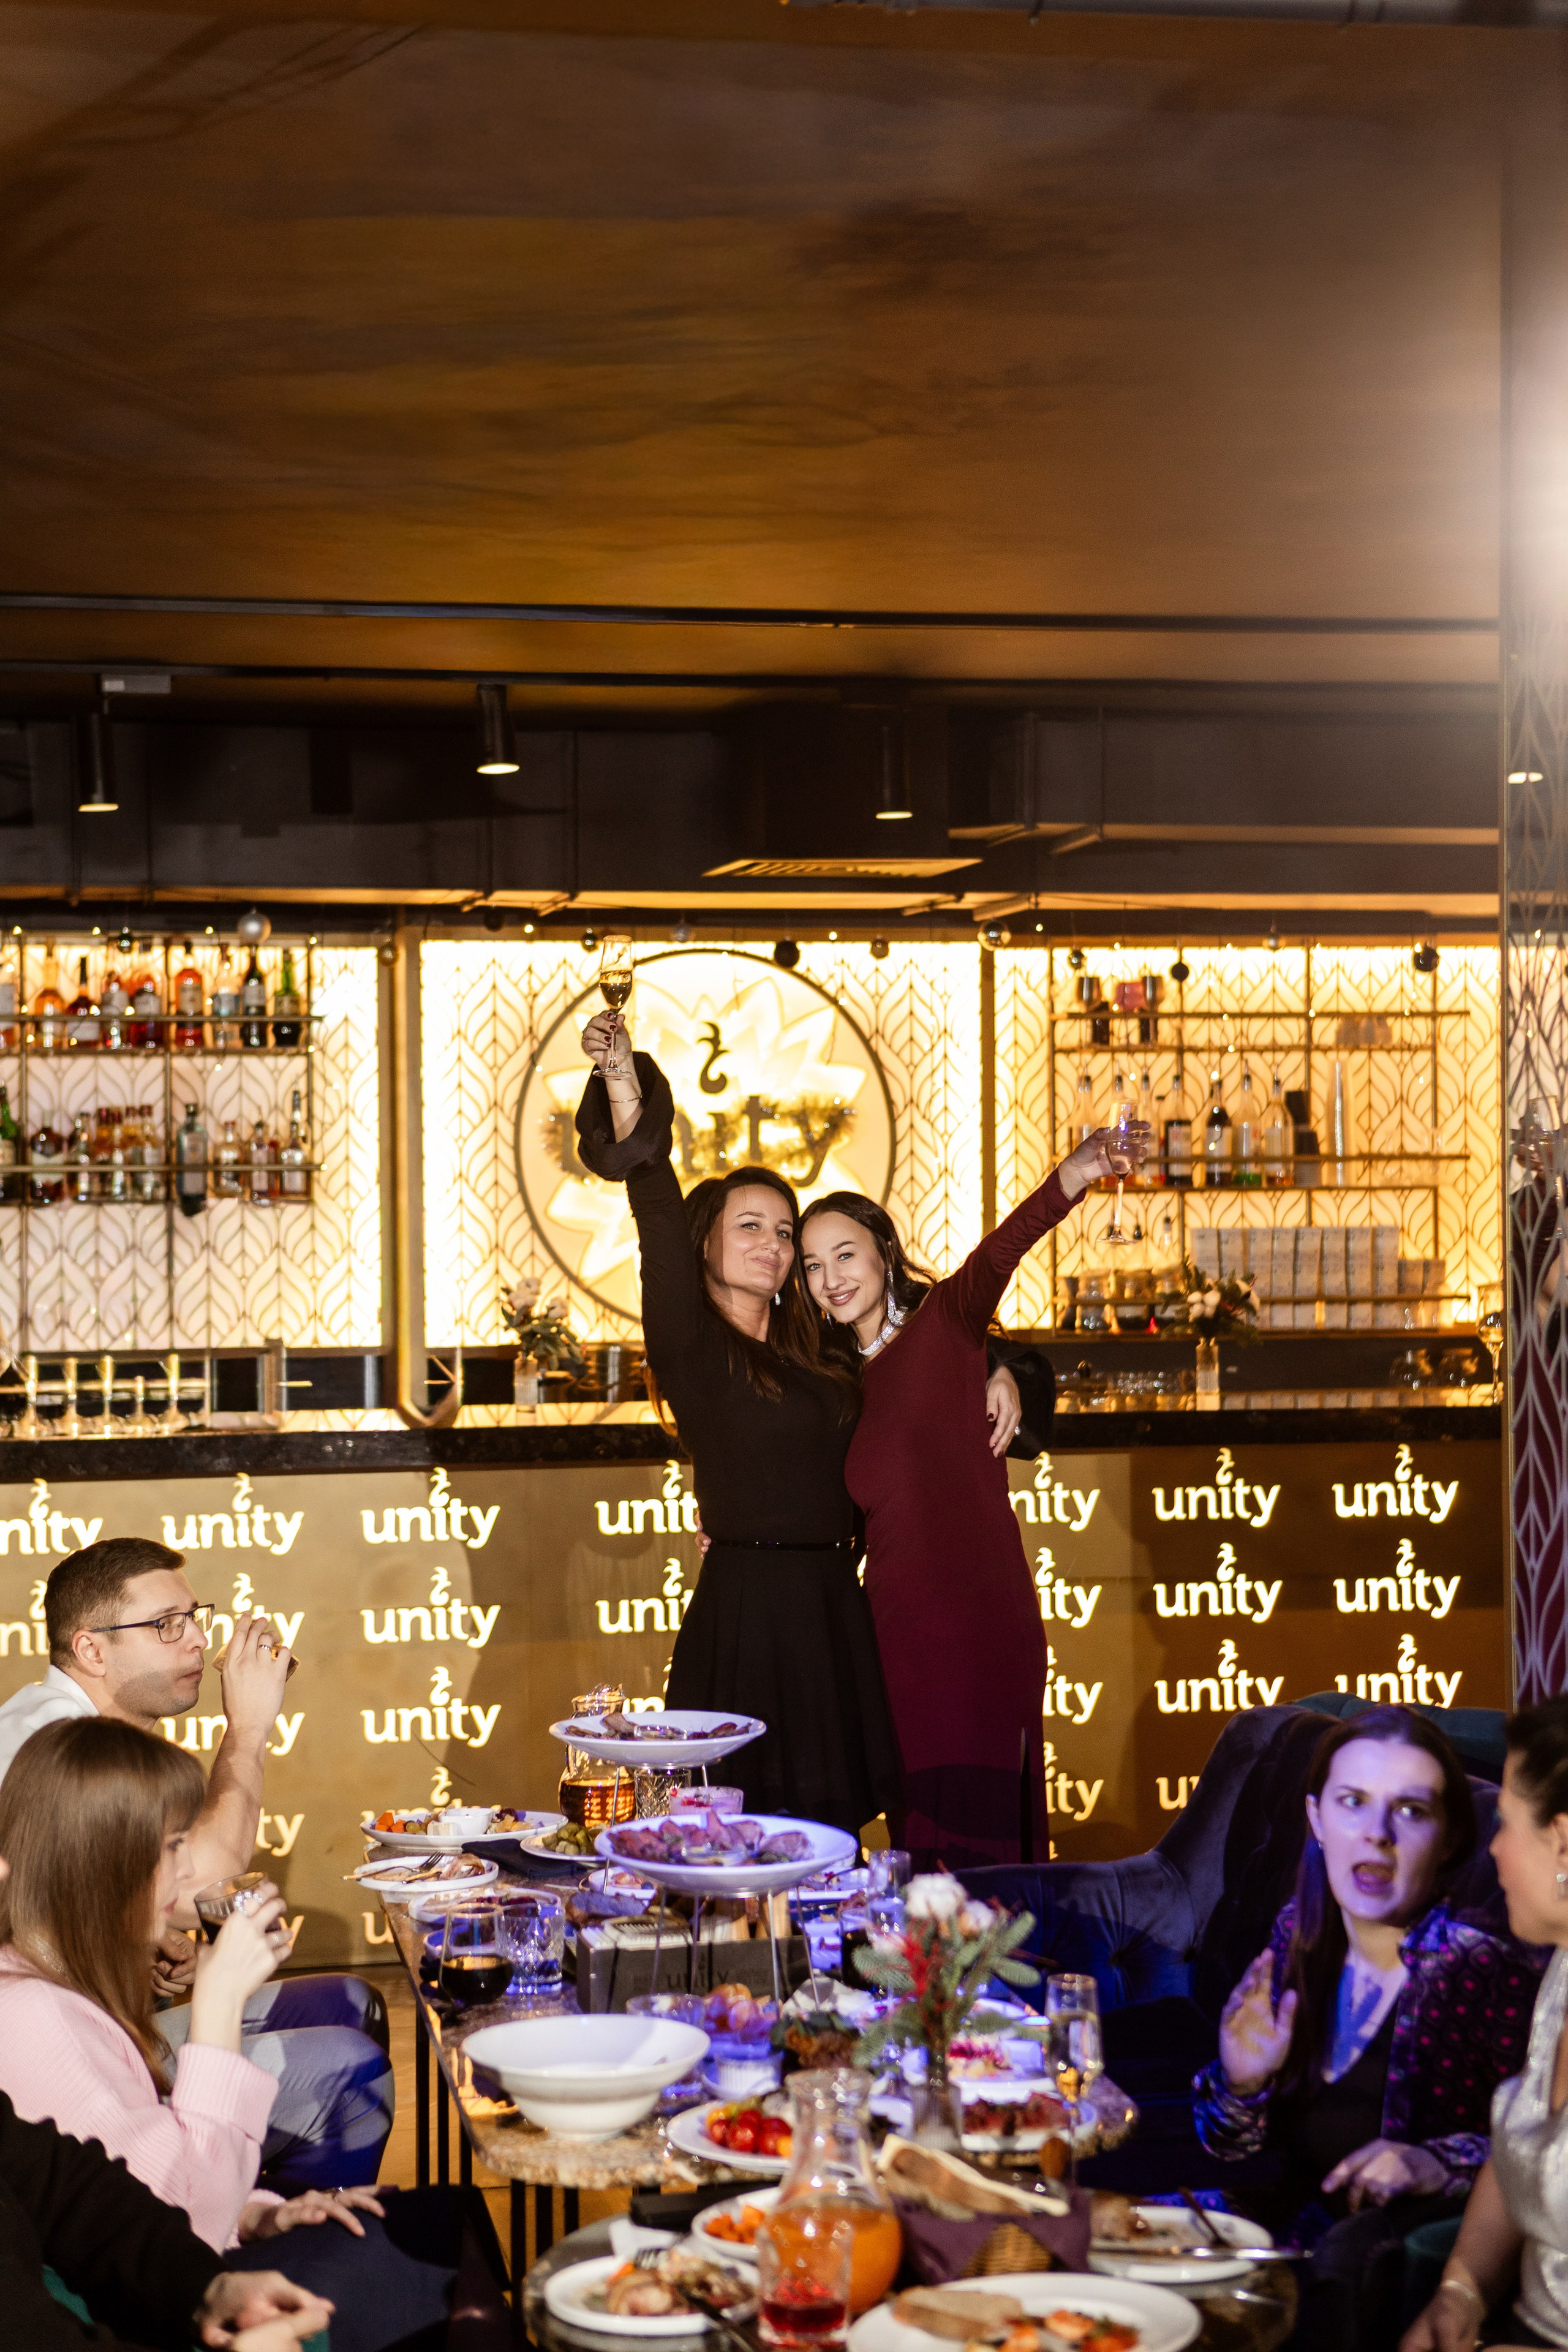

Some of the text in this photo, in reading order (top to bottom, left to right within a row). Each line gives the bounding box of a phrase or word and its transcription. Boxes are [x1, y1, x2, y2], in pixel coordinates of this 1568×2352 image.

[0, 1478, 103, 1555] nity
[161, 1472, 304, 1556] unity
[361, 1467, 500, 1548] unity
[594, 1460, 698, 1535] unit
[1008, 1451, 1101, 1532] nity
[1152, 1447, 1281, 1528] unity
[1332, 1444, 1459, 1524] unity
[360, 1566, 500, 1648] unity
[595, 1558, 694, 1634] uni
[1035, 1547, 1102, 1629] ity
[1153, 1542, 1283, 1623] unity
[1333, 1538, 1461, 1619] unity
[361, 1666, 501, 1747] unity
[1042, 1645, 1103, 1724] ity
[1154, 1638, 1284, 1713] unity
[1044, 1741, 1104, 1821] ity
